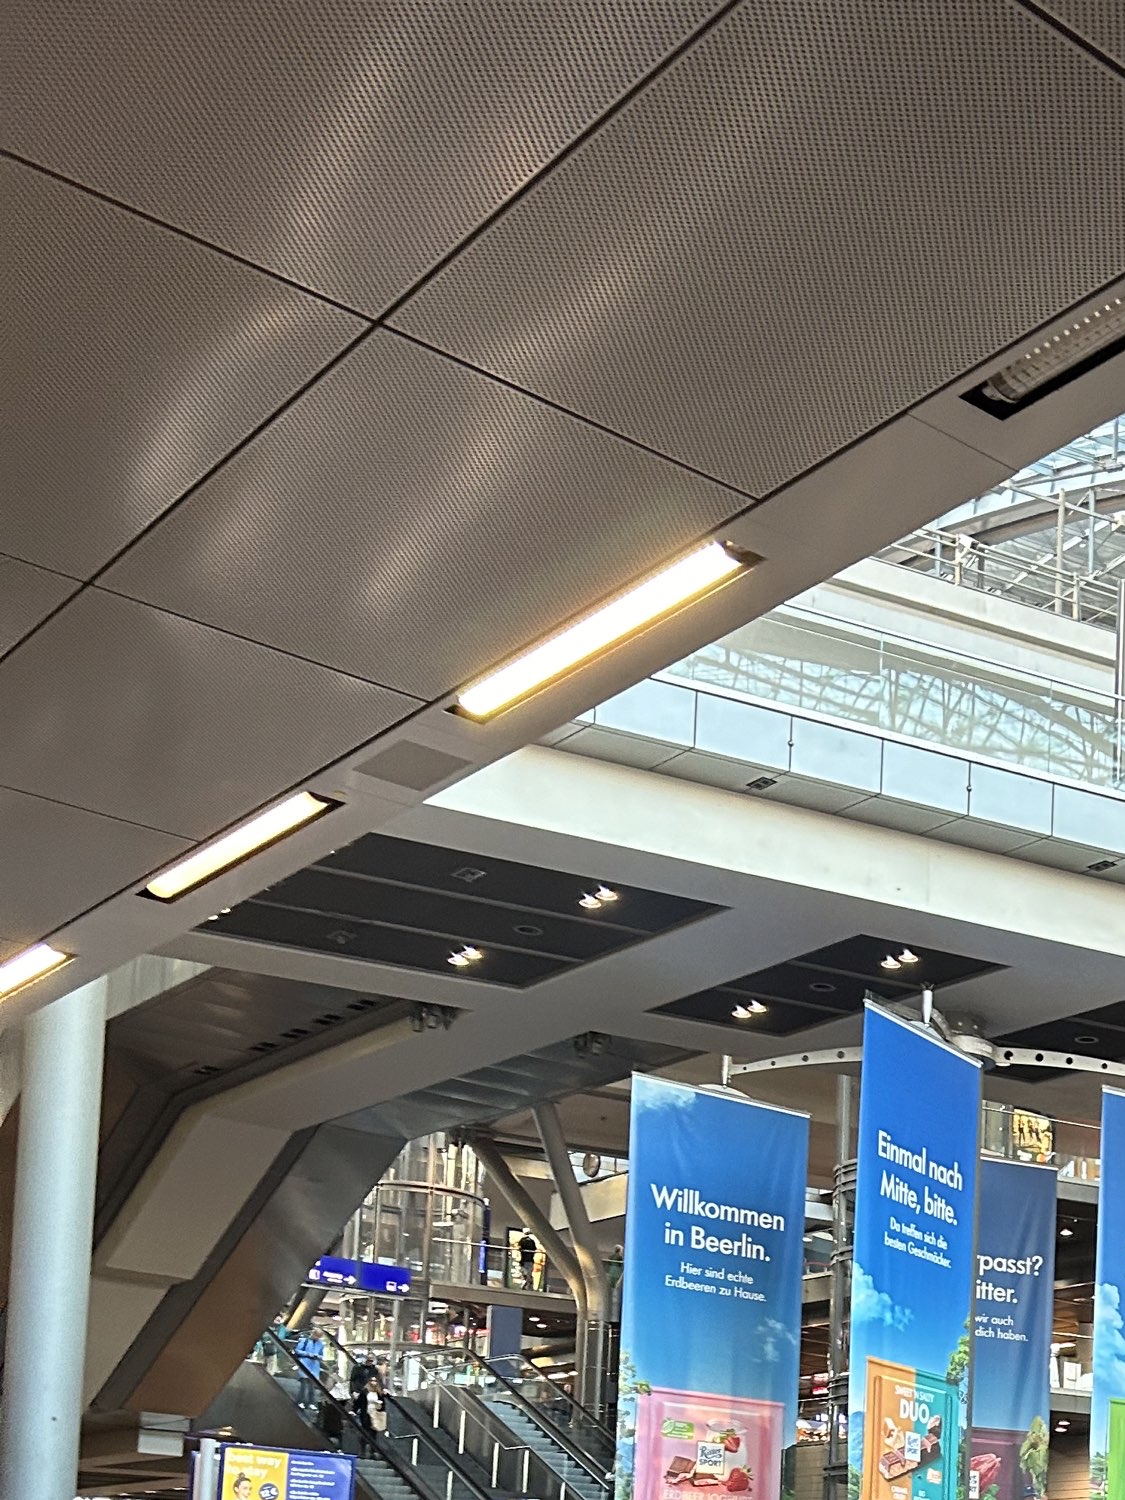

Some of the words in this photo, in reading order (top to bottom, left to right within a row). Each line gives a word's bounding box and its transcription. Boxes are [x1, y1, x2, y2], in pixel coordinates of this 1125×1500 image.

[877, 1130, 926, 1175] Einmal
[929, 1161, 963, 1191] nach
[650, 1183, 785, 1231] Willkommen
[880, 1170, 921, 1215] Mitte,
[924, 1186, 958, 1226] bitte.
[664, 1222, 684, 1246] in
[691, 1225, 771, 1262] Beerlin.
[680, 1261, 702, 1276] Hier
[704, 1267, 725, 1280] sind
[727, 1270, 754, 1285] echte
[665, 1275, 716, 1294] Erdbeeren
[719, 1287, 732, 1297] zu
[733, 1286, 767, 1302] Hause.
[975, 1279, 1018, 1304] itter.
[975, 1324, 995, 1338] dich
[997, 1326, 1029, 1342] haben.
[991, 1315, 1014, 1327] auch
[899, 1398, 930, 1424] DUO
[699, 1458, 722, 1468] SPORT
